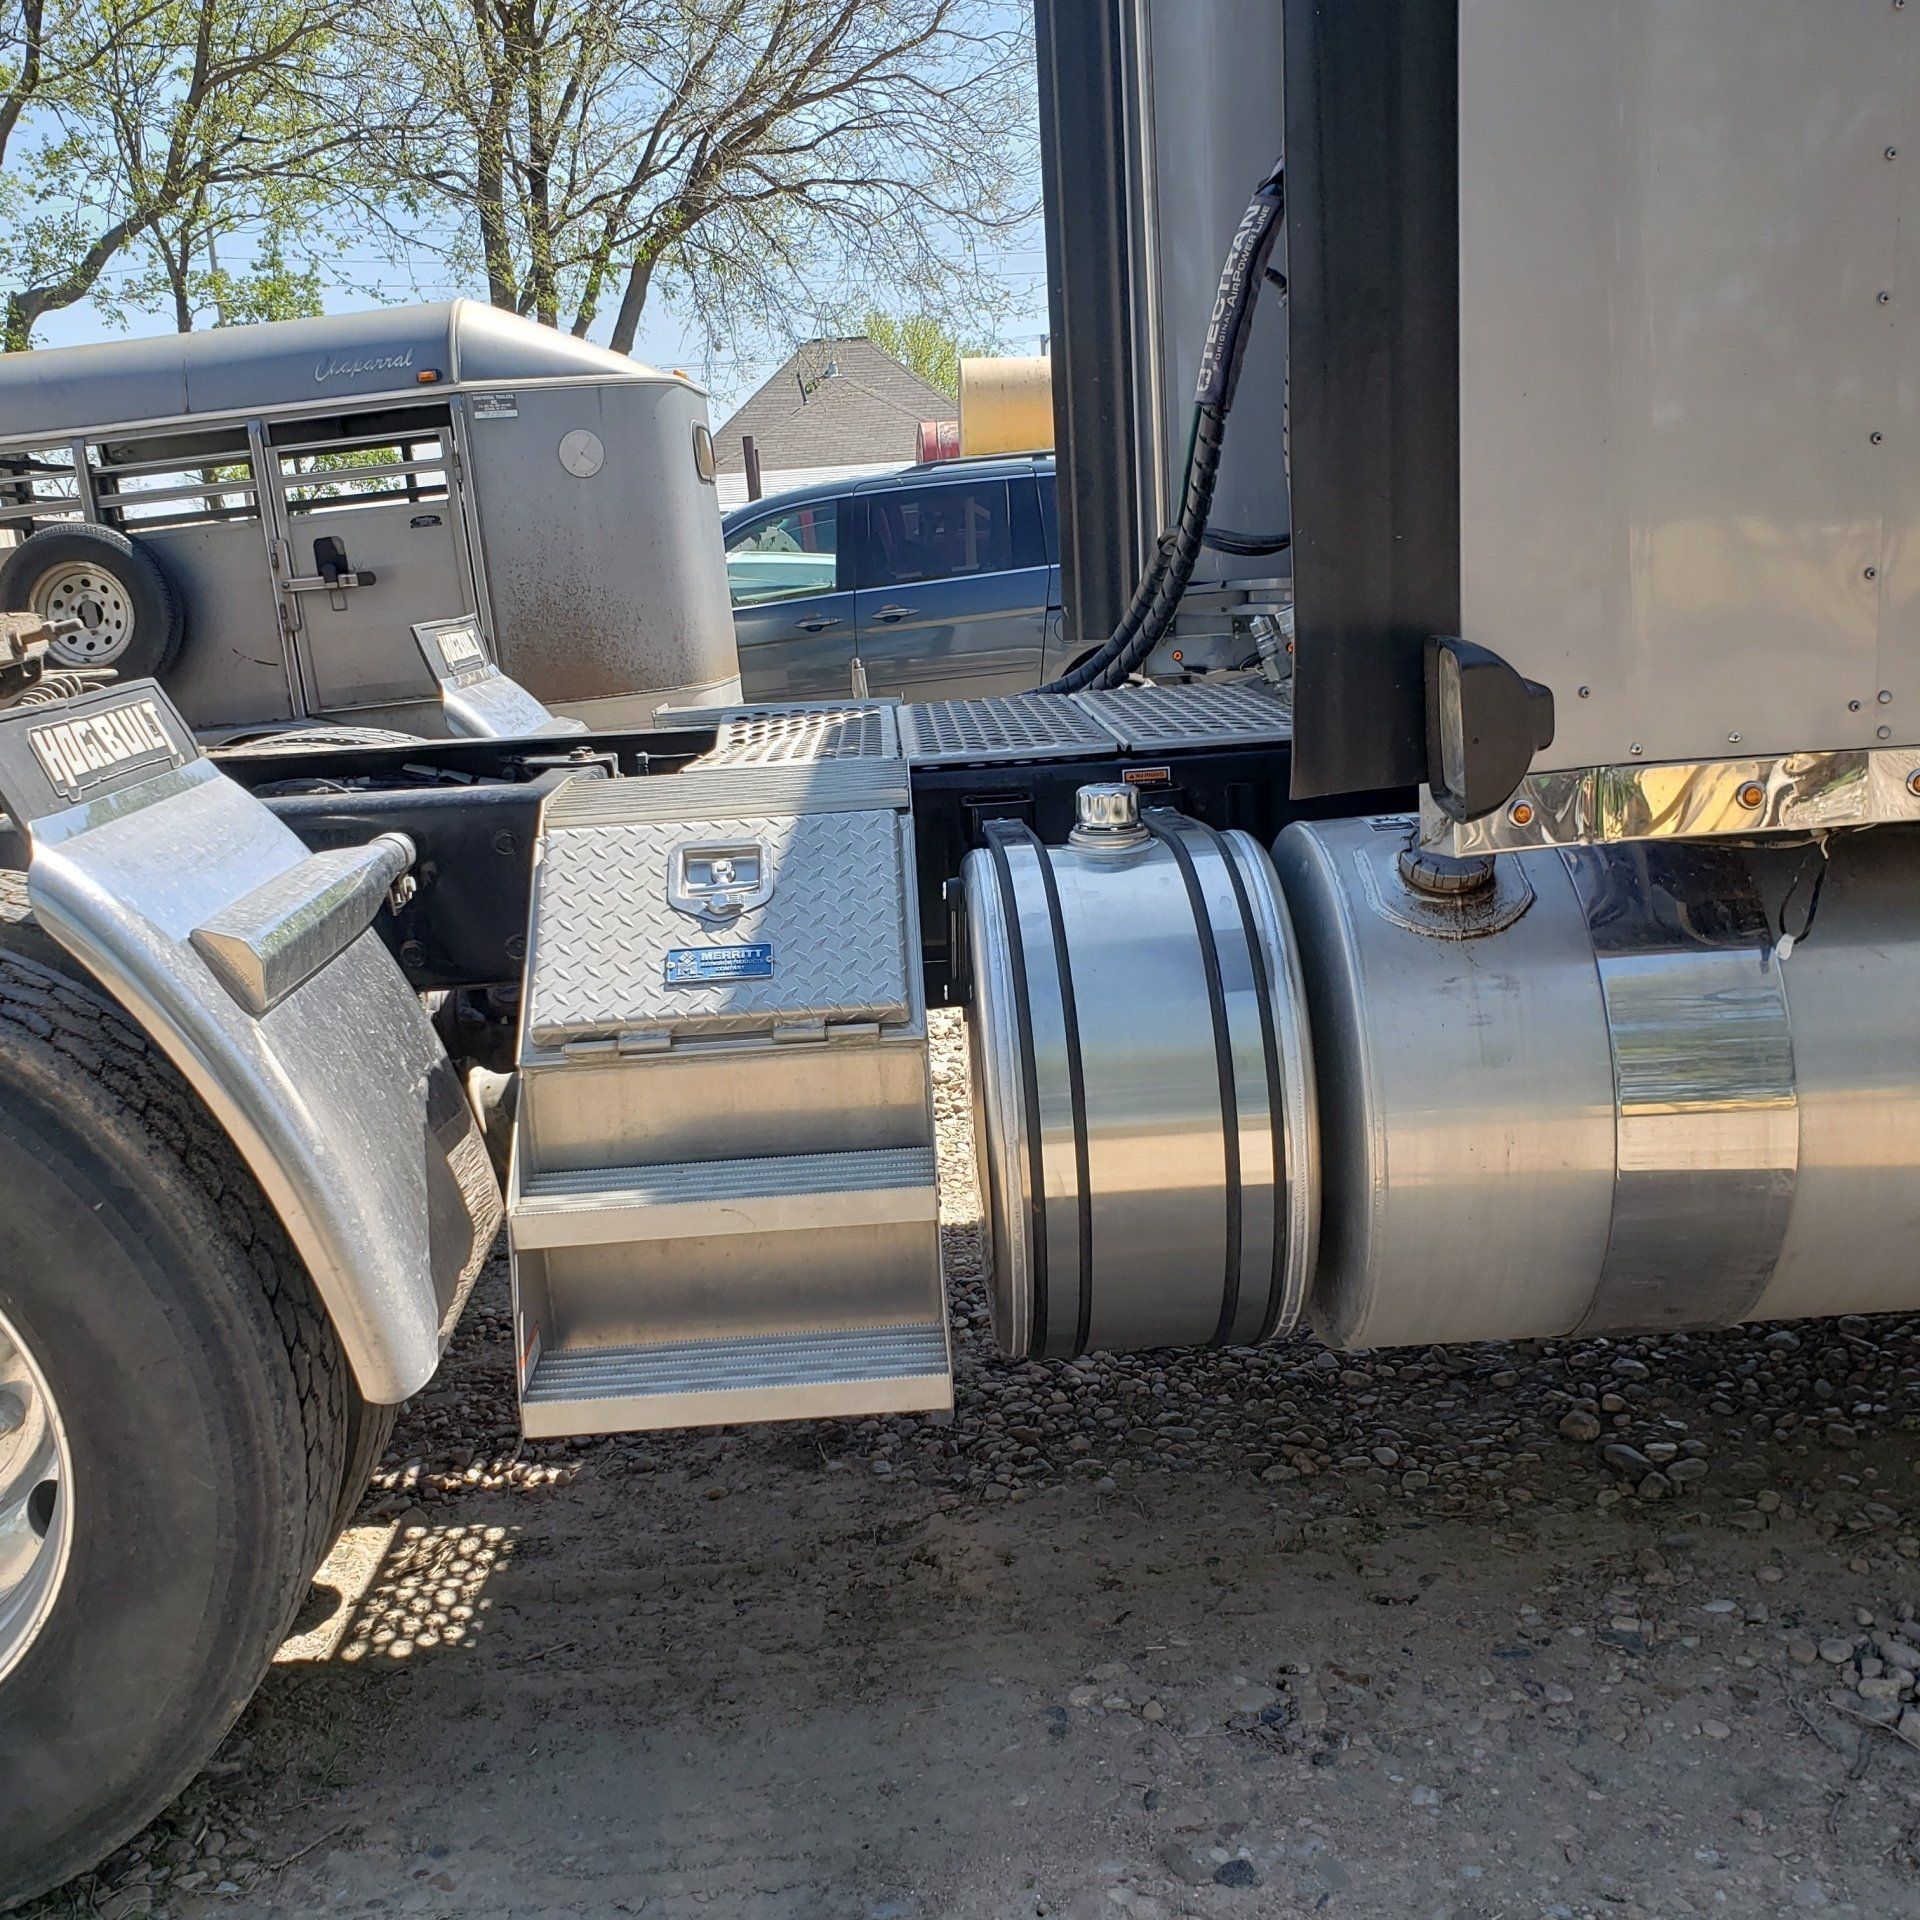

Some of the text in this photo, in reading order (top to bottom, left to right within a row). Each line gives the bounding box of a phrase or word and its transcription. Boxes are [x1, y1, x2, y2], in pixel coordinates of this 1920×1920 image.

[1201, 205, 1261, 368] TECTRAN
[1215, 310, 1232, 361] ORIGINAL
[314, 348, 413, 382] Chaparral
[701, 949, 763, 961] MERRITT
